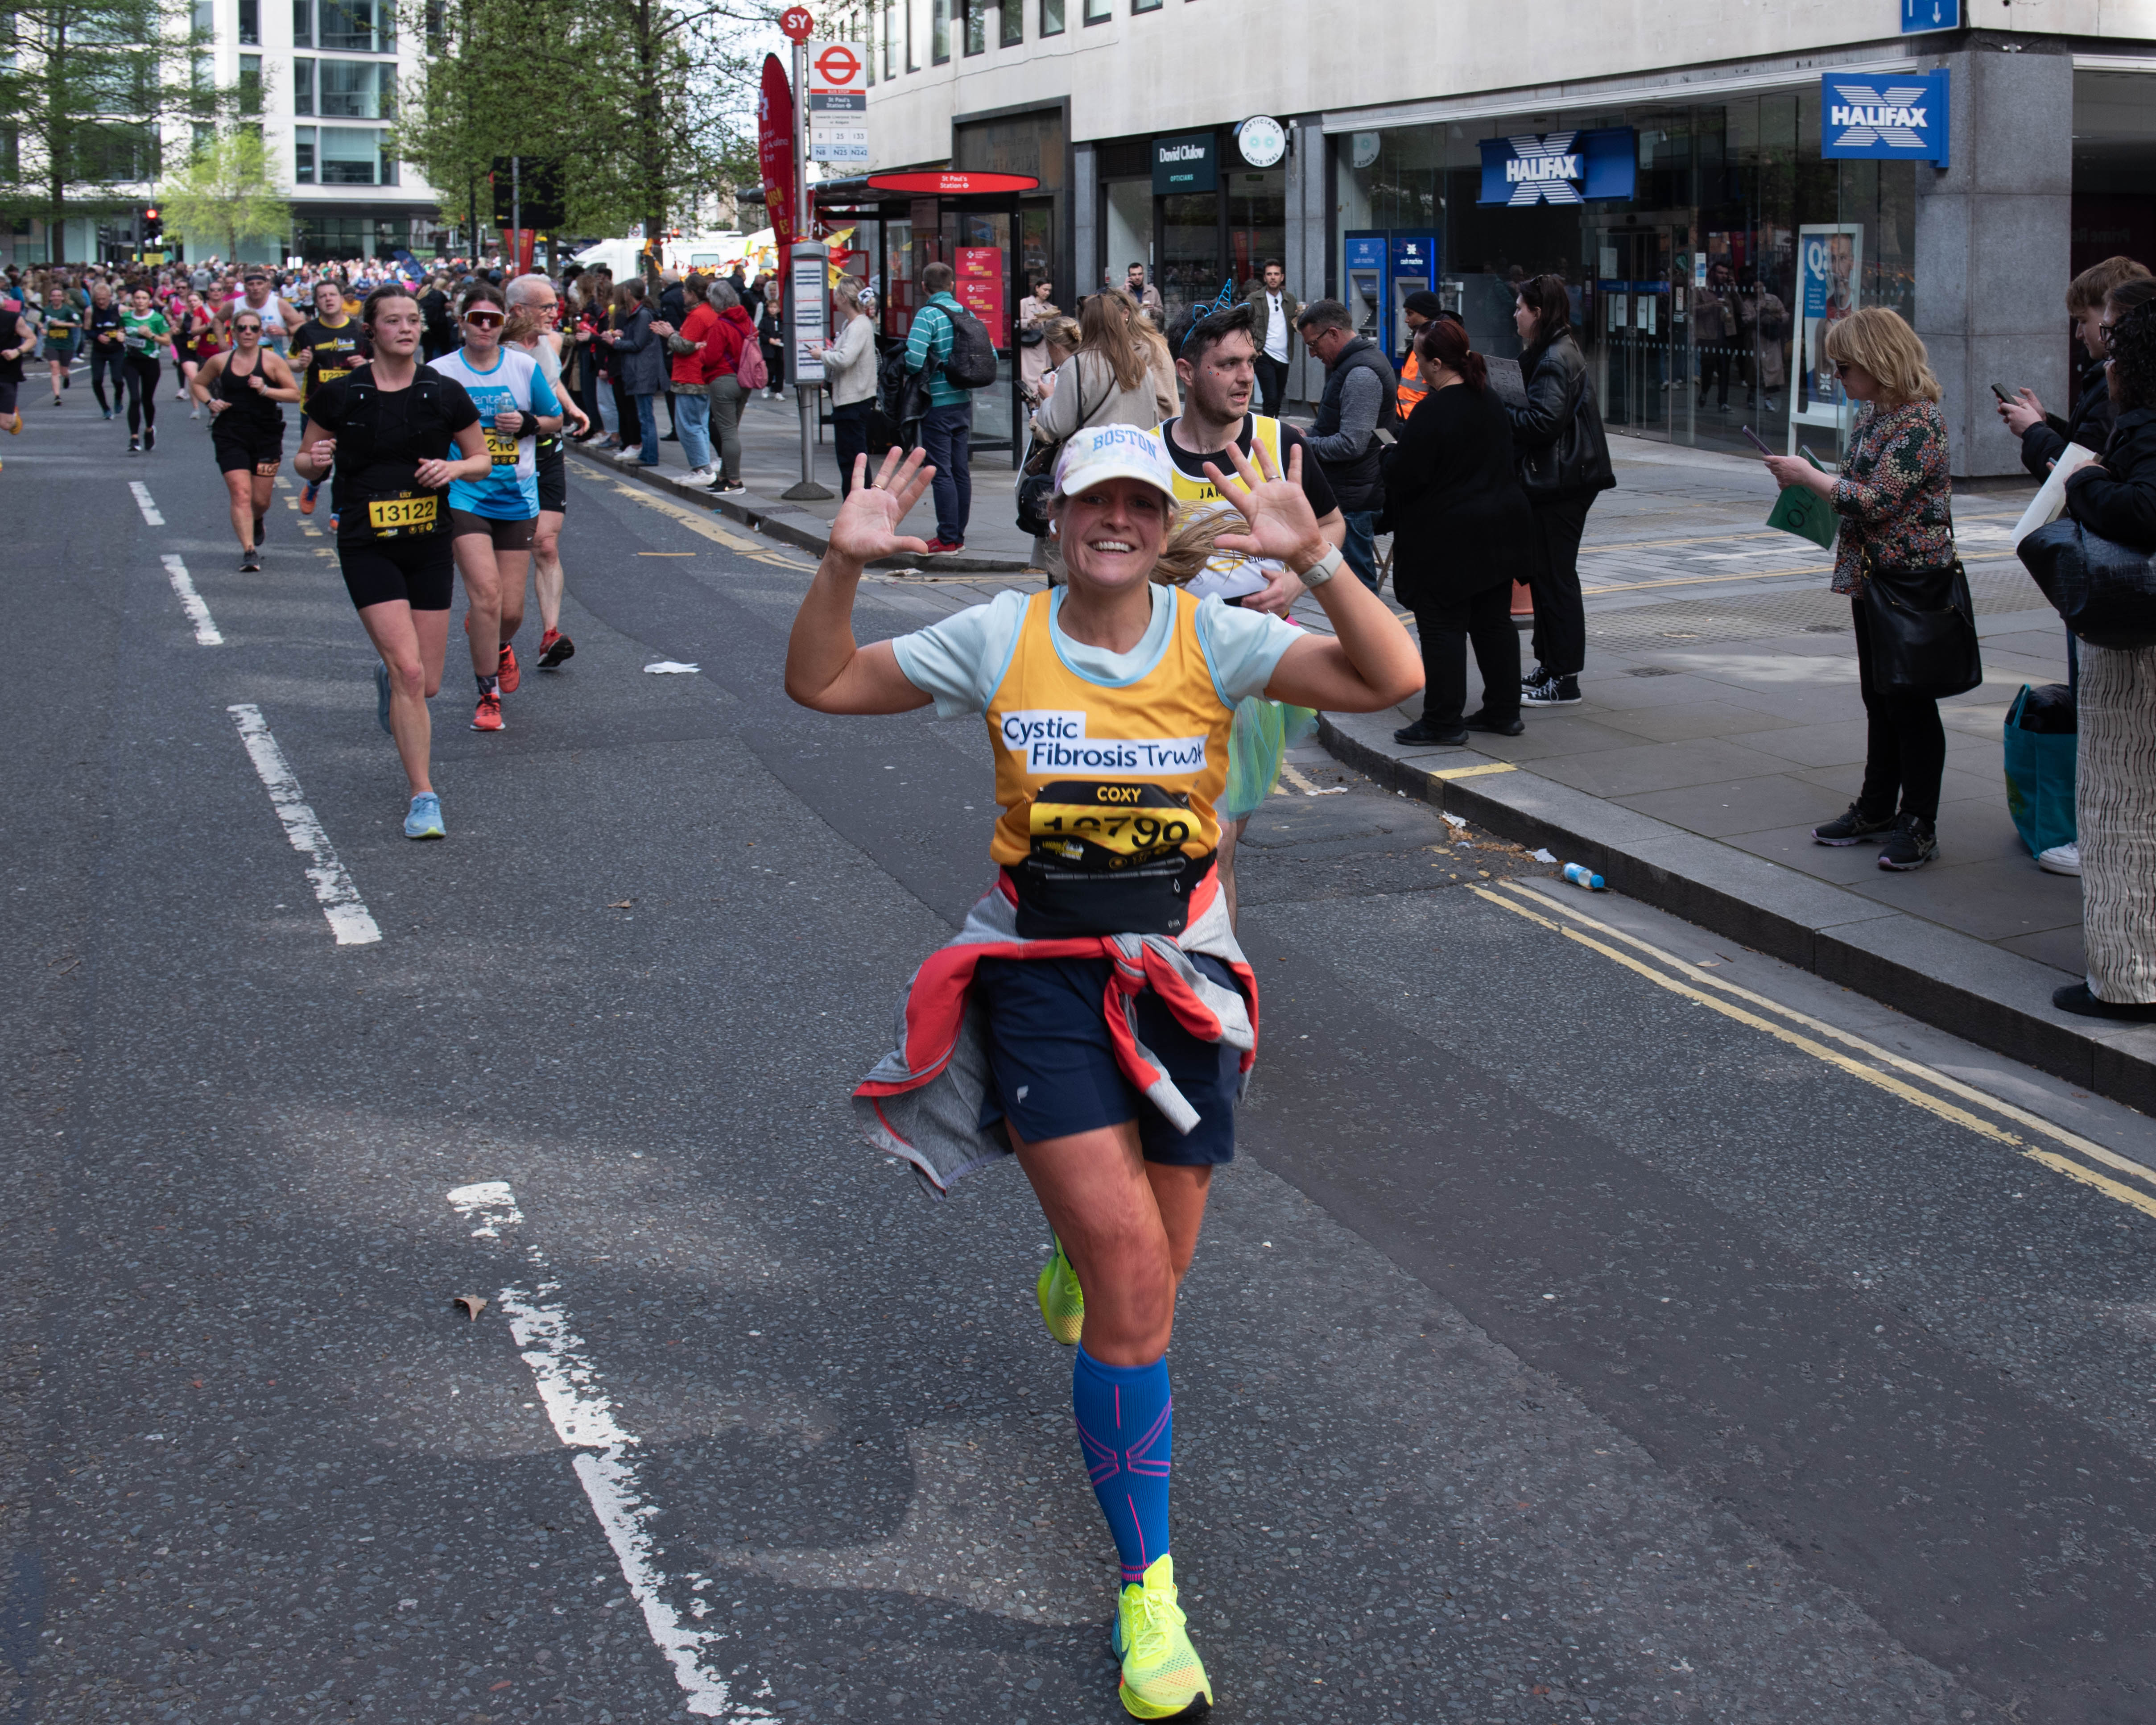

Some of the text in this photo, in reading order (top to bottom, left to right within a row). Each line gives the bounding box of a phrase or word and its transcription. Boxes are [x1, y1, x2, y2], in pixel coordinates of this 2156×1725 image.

[788, 14, 808, 29] SY
[1244, 119, 1280, 134] OPTICIANS
[1831, 106, 1928, 128] HALIFAX
[1160, 144, 1205, 162] David Clulow
[1245, 152, 1263, 165] SINCE
[1506, 155, 1578, 182] HALIFAX
[1093, 429, 1157, 461] BOSTON
[375, 501, 434, 522] 13122
[1004, 716, 1078, 745] Cystic
[1033, 742, 1203, 767] Fibrosis Trust
[1097, 786, 1142, 803] COXY
